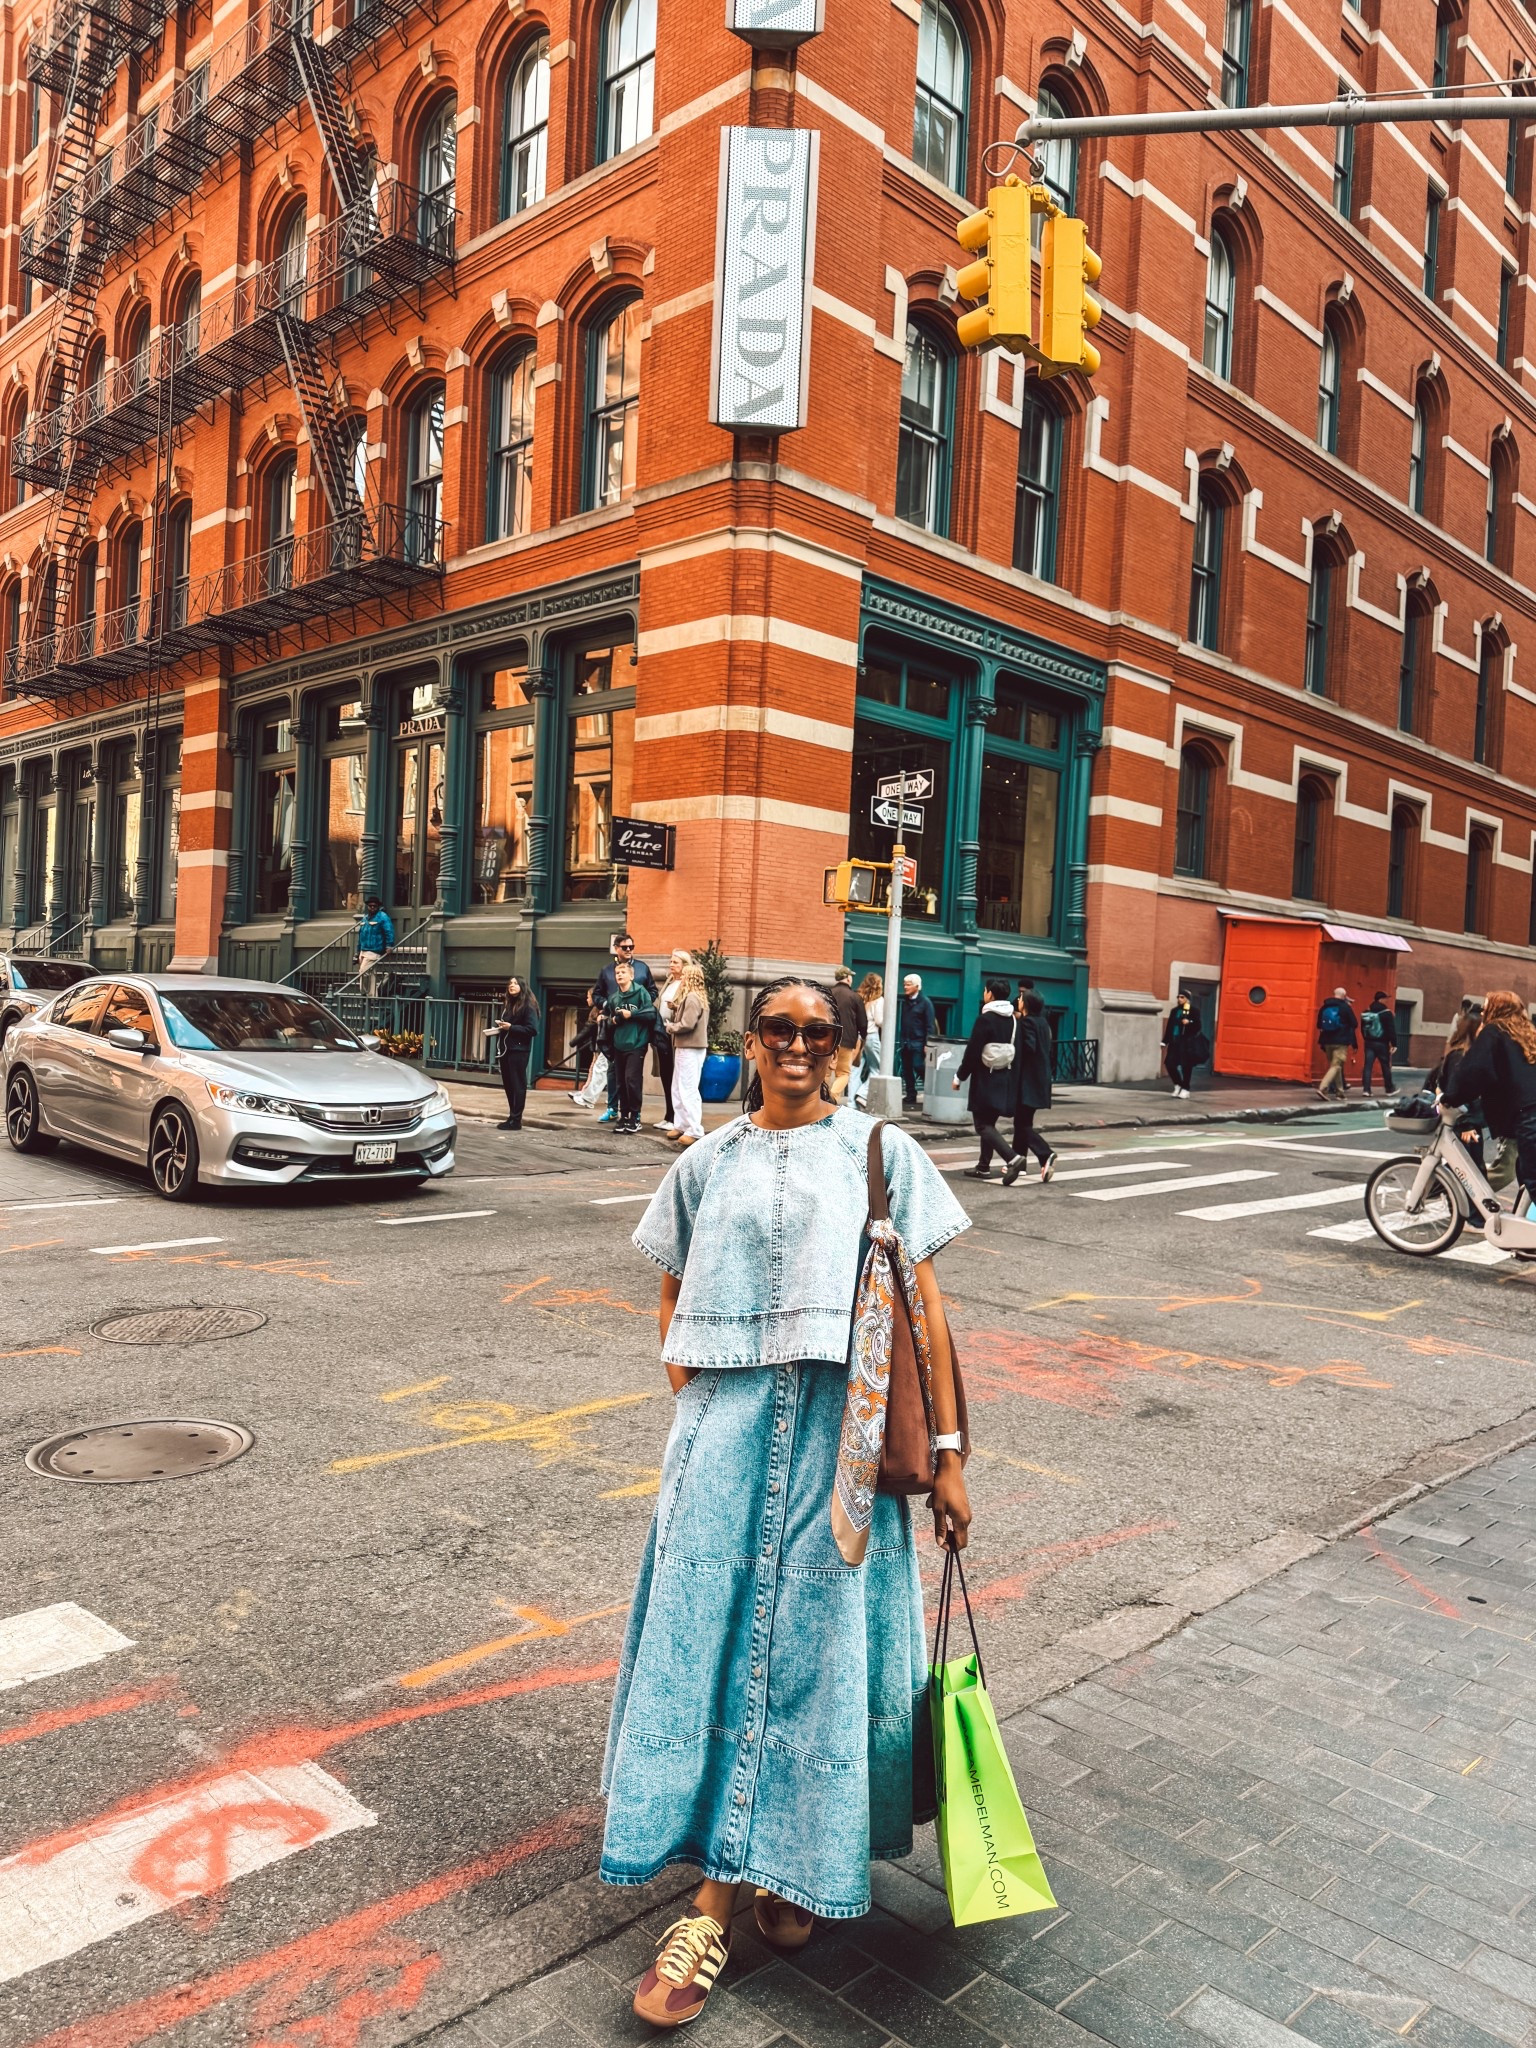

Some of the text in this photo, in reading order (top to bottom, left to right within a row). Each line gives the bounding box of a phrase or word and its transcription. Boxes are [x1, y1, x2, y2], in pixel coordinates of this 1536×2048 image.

[733, 127, 795, 422] PRADA
[399, 716, 441, 736] PRADA
[885, 780, 924, 796] ONE WAY
[882, 807, 918, 824] ONE WAY
